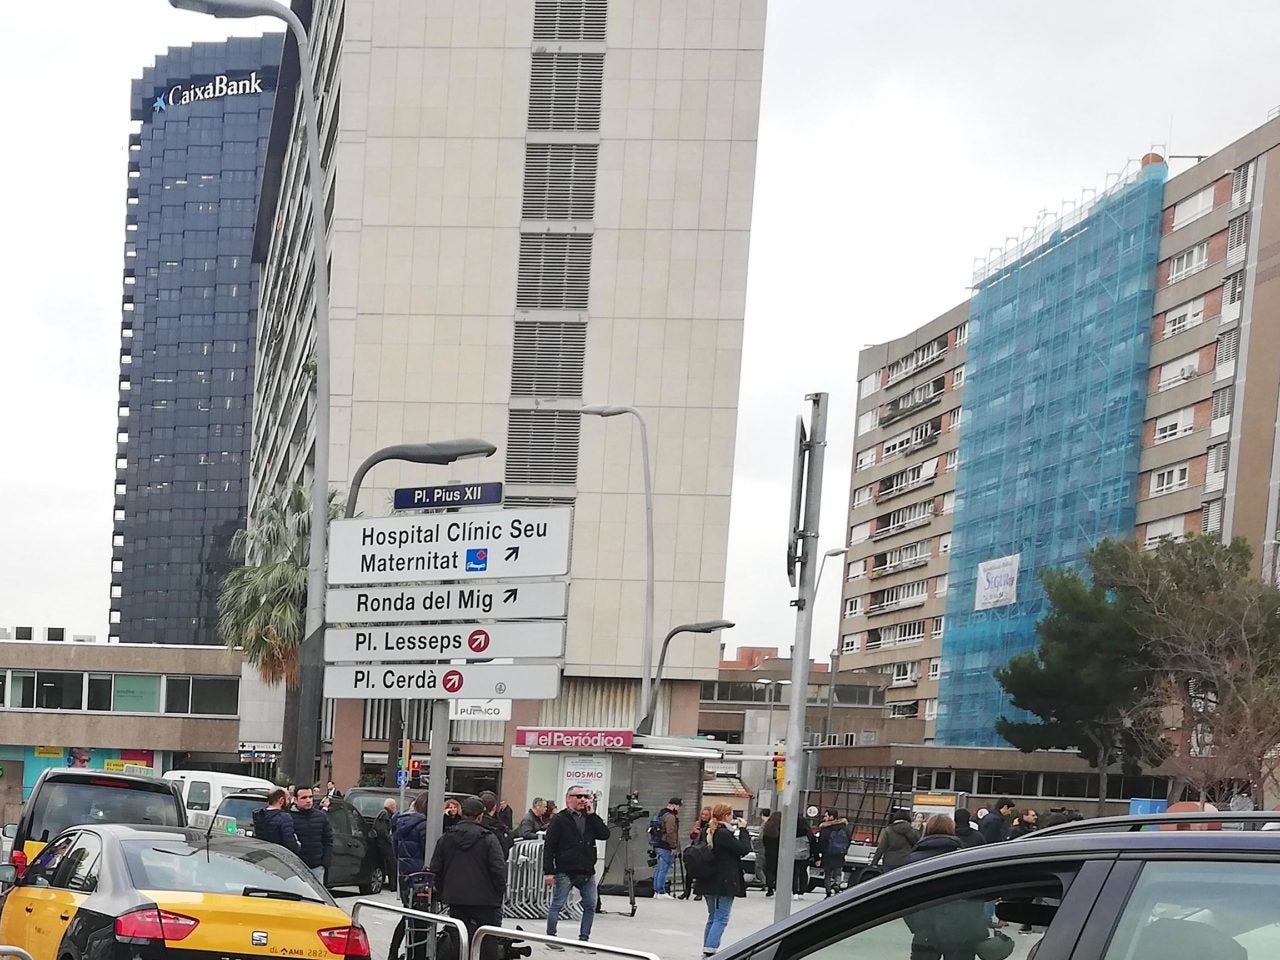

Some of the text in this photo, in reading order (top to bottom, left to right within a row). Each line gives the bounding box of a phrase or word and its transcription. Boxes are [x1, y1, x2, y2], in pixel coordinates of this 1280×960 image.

[168, 72, 262, 106] CaixaBank
[414, 486, 481, 503] Pl. Pius XII
[361, 518, 547, 548] Hospital Clínic Seu
[361, 551, 458, 573] Maternitat
[356, 588, 493, 612] Ronda del Mig
[355, 632, 462, 653] Pl. Lesseps
[353, 669, 437, 689] Pl. Cerdà
[553, 732, 624, 747] Periódico
